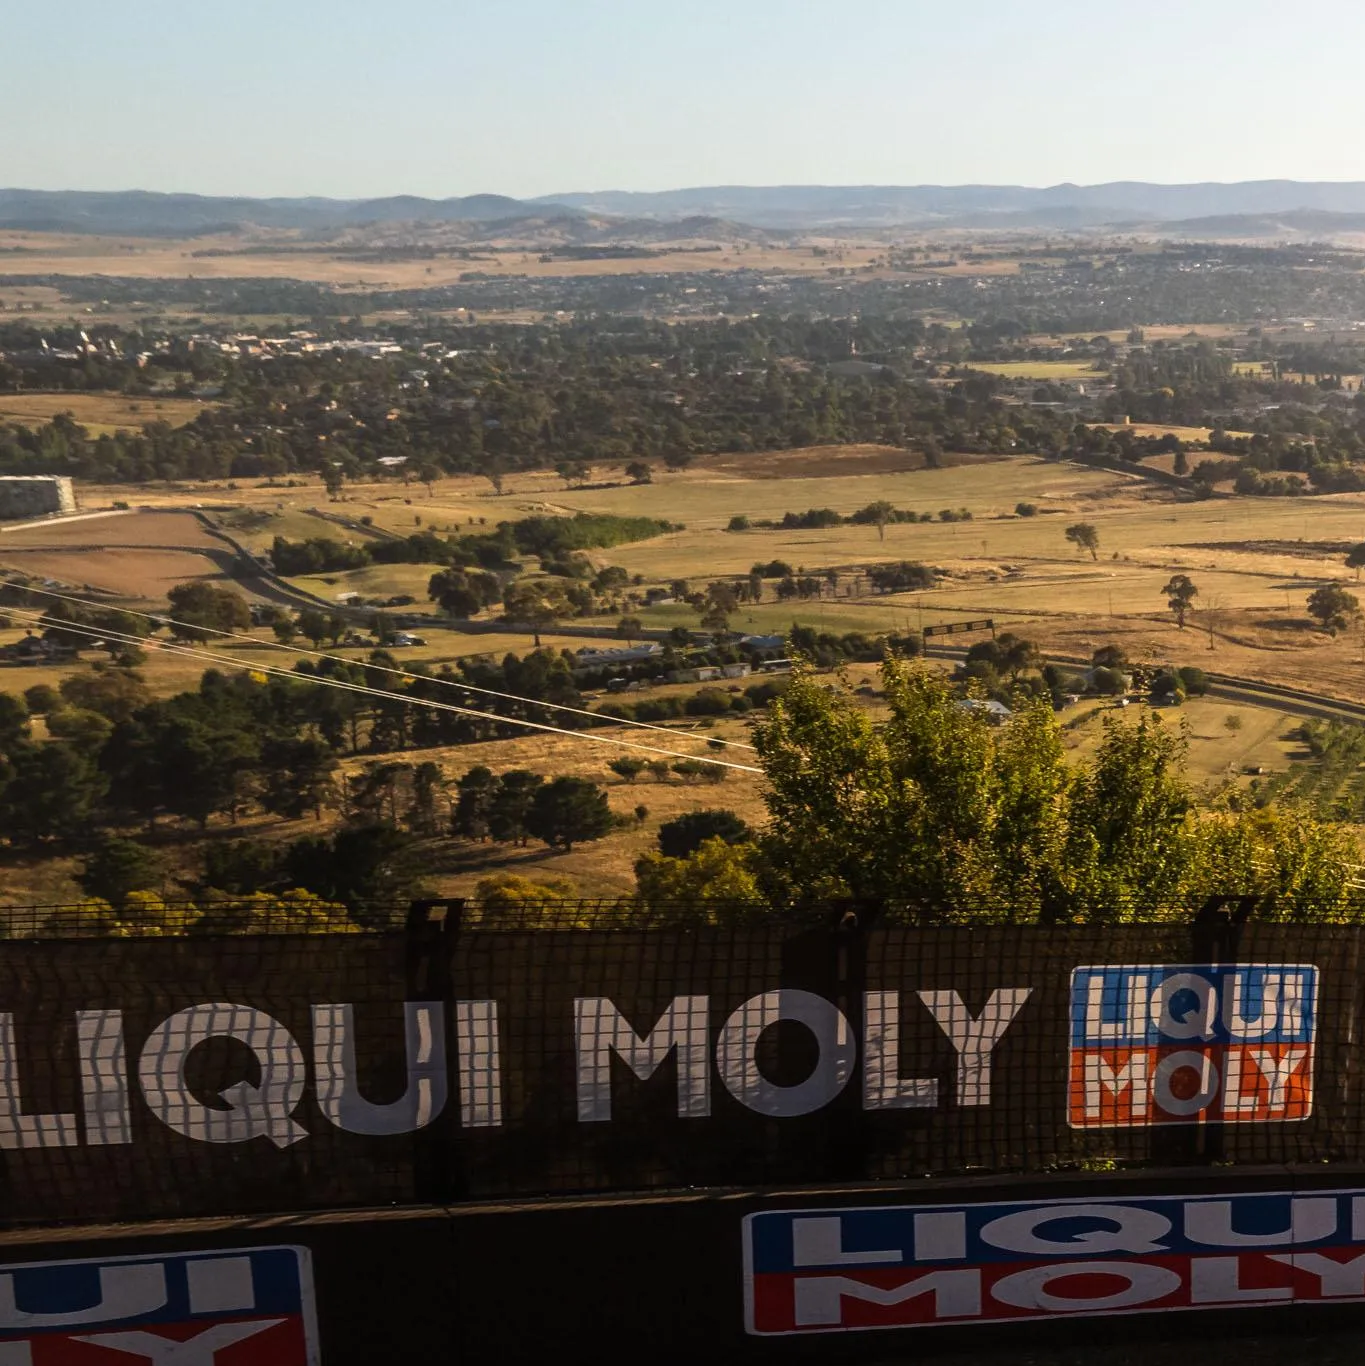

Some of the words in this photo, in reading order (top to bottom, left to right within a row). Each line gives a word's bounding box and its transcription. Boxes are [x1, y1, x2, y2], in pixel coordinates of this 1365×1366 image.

[1084, 973, 1305, 1042] LIQUI
[574, 987, 1034, 1122] MOLY
[1085, 1049, 1308, 1117] MOLY
